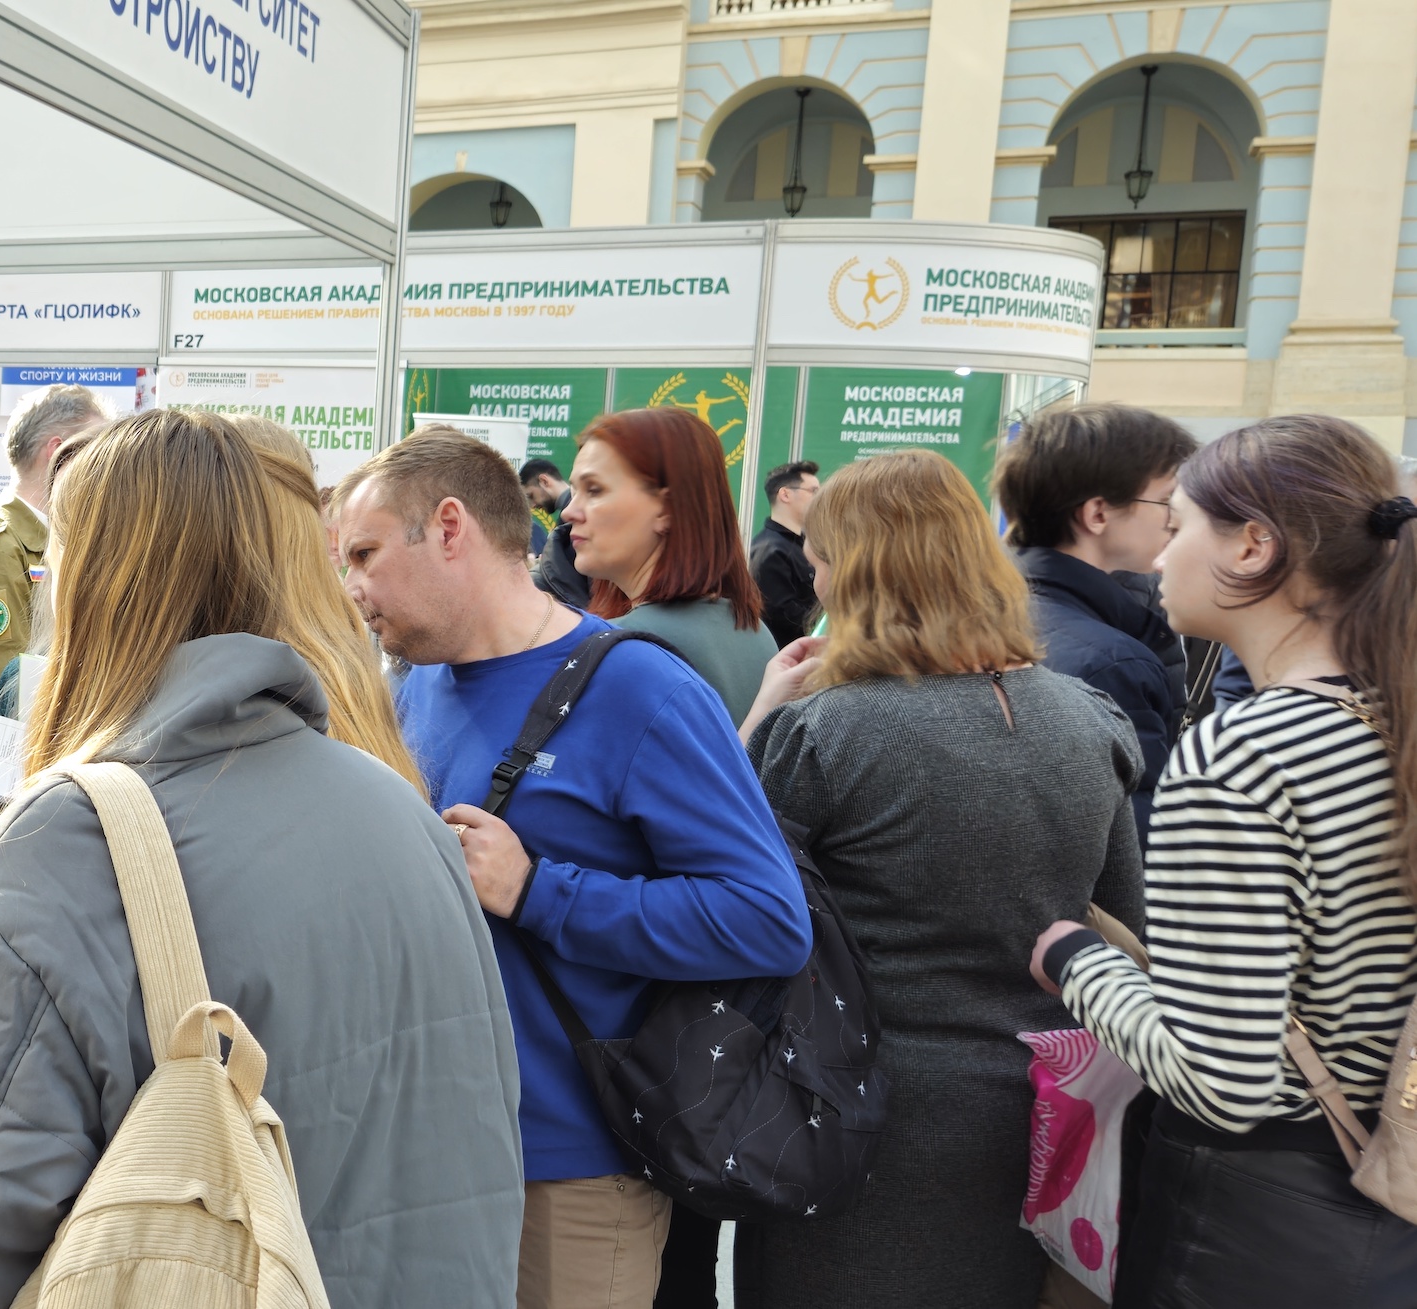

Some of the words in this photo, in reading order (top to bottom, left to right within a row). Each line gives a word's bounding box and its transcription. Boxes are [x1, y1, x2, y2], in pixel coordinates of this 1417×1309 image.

[235, 0, 320, 63] СИТЕТ
[925, 267, 1051, 294] МОСКОВСКАЯ
[193, 286, 322, 304] МОСКОВСКАЯ
[328, 283, 442, 304] АКАДМИЯ
[448, 276, 730, 302] ПРЕДПРИНИМАТЕЛЬСТВА
[34, 303, 141, 321] «ГЦОЛИФК»
[193, 309, 254, 320] ОСНОВАНА
[257, 308, 325, 320] РЕШЕНИЕМ
[434, 305, 489, 317] МОСКВЫ
[494, 305, 502, 317] В
[507, 304, 535, 317] 1997
[539, 304, 576, 319] ГОДУ
[174, 334, 204, 348] F27
[19, 371, 64, 381] СПОРТУ
[67, 371, 75, 381] И
[78, 371, 122, 382] ЖИЗНИ
[469, 384, 572, 400] МОСКОВСКАЯ
[844, 385, 964, 403] МОСКОВСКАЯ
[468, 403, 570, 422] АКАДЕМИЯ
[841, 406, 962, 429] АКАДЕМИЯ
[840, 430, 960, 444] ПРЕДПРИНИМАТЕЛЬСТВА
